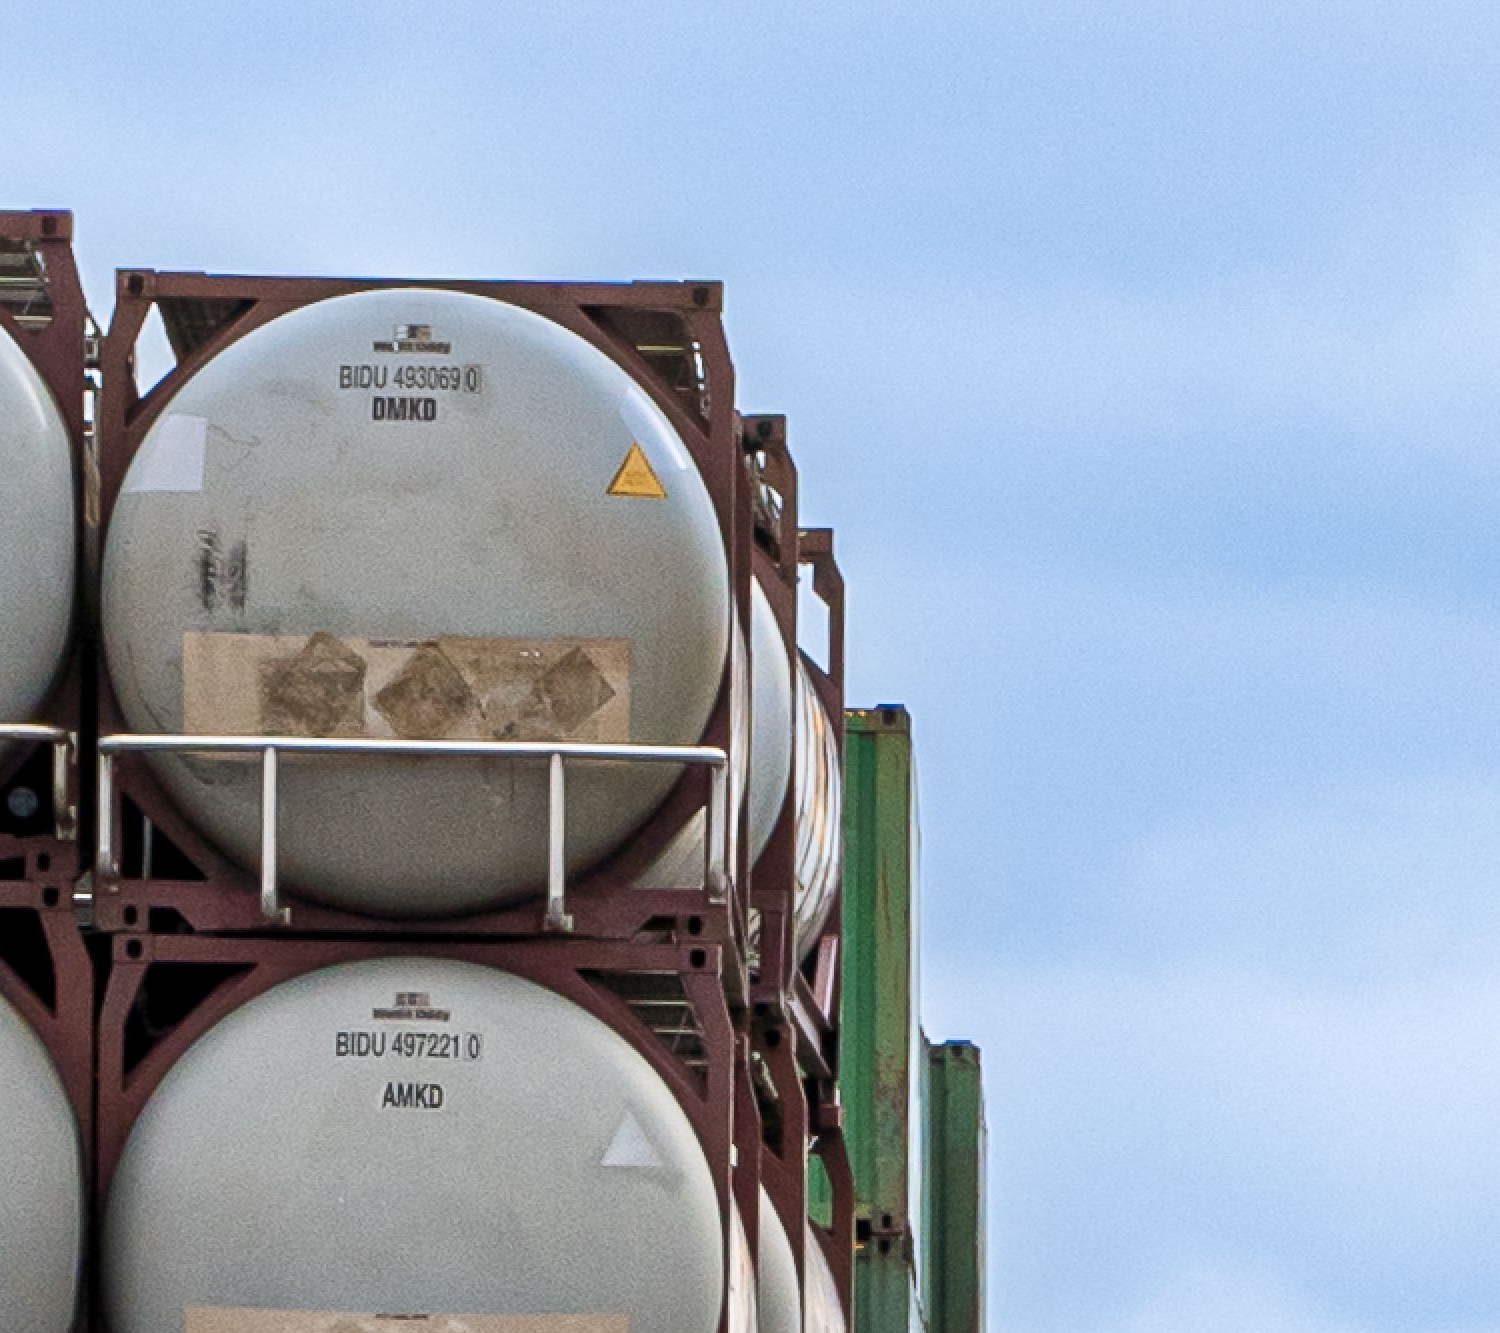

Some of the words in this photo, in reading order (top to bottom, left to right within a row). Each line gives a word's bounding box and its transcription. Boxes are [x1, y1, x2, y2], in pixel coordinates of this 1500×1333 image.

[340, 365, 388, 389] BIDU
[393, 365, 461, 391] 493069
[373, 397, 437, 421] DMKD
[336, 1032, 387, 1057] BIDU
[391, 1032, 460, 1059] 497221
[467, 1033, 482, 1059] 0
[382, 1082, 444, 1109] AMKD
